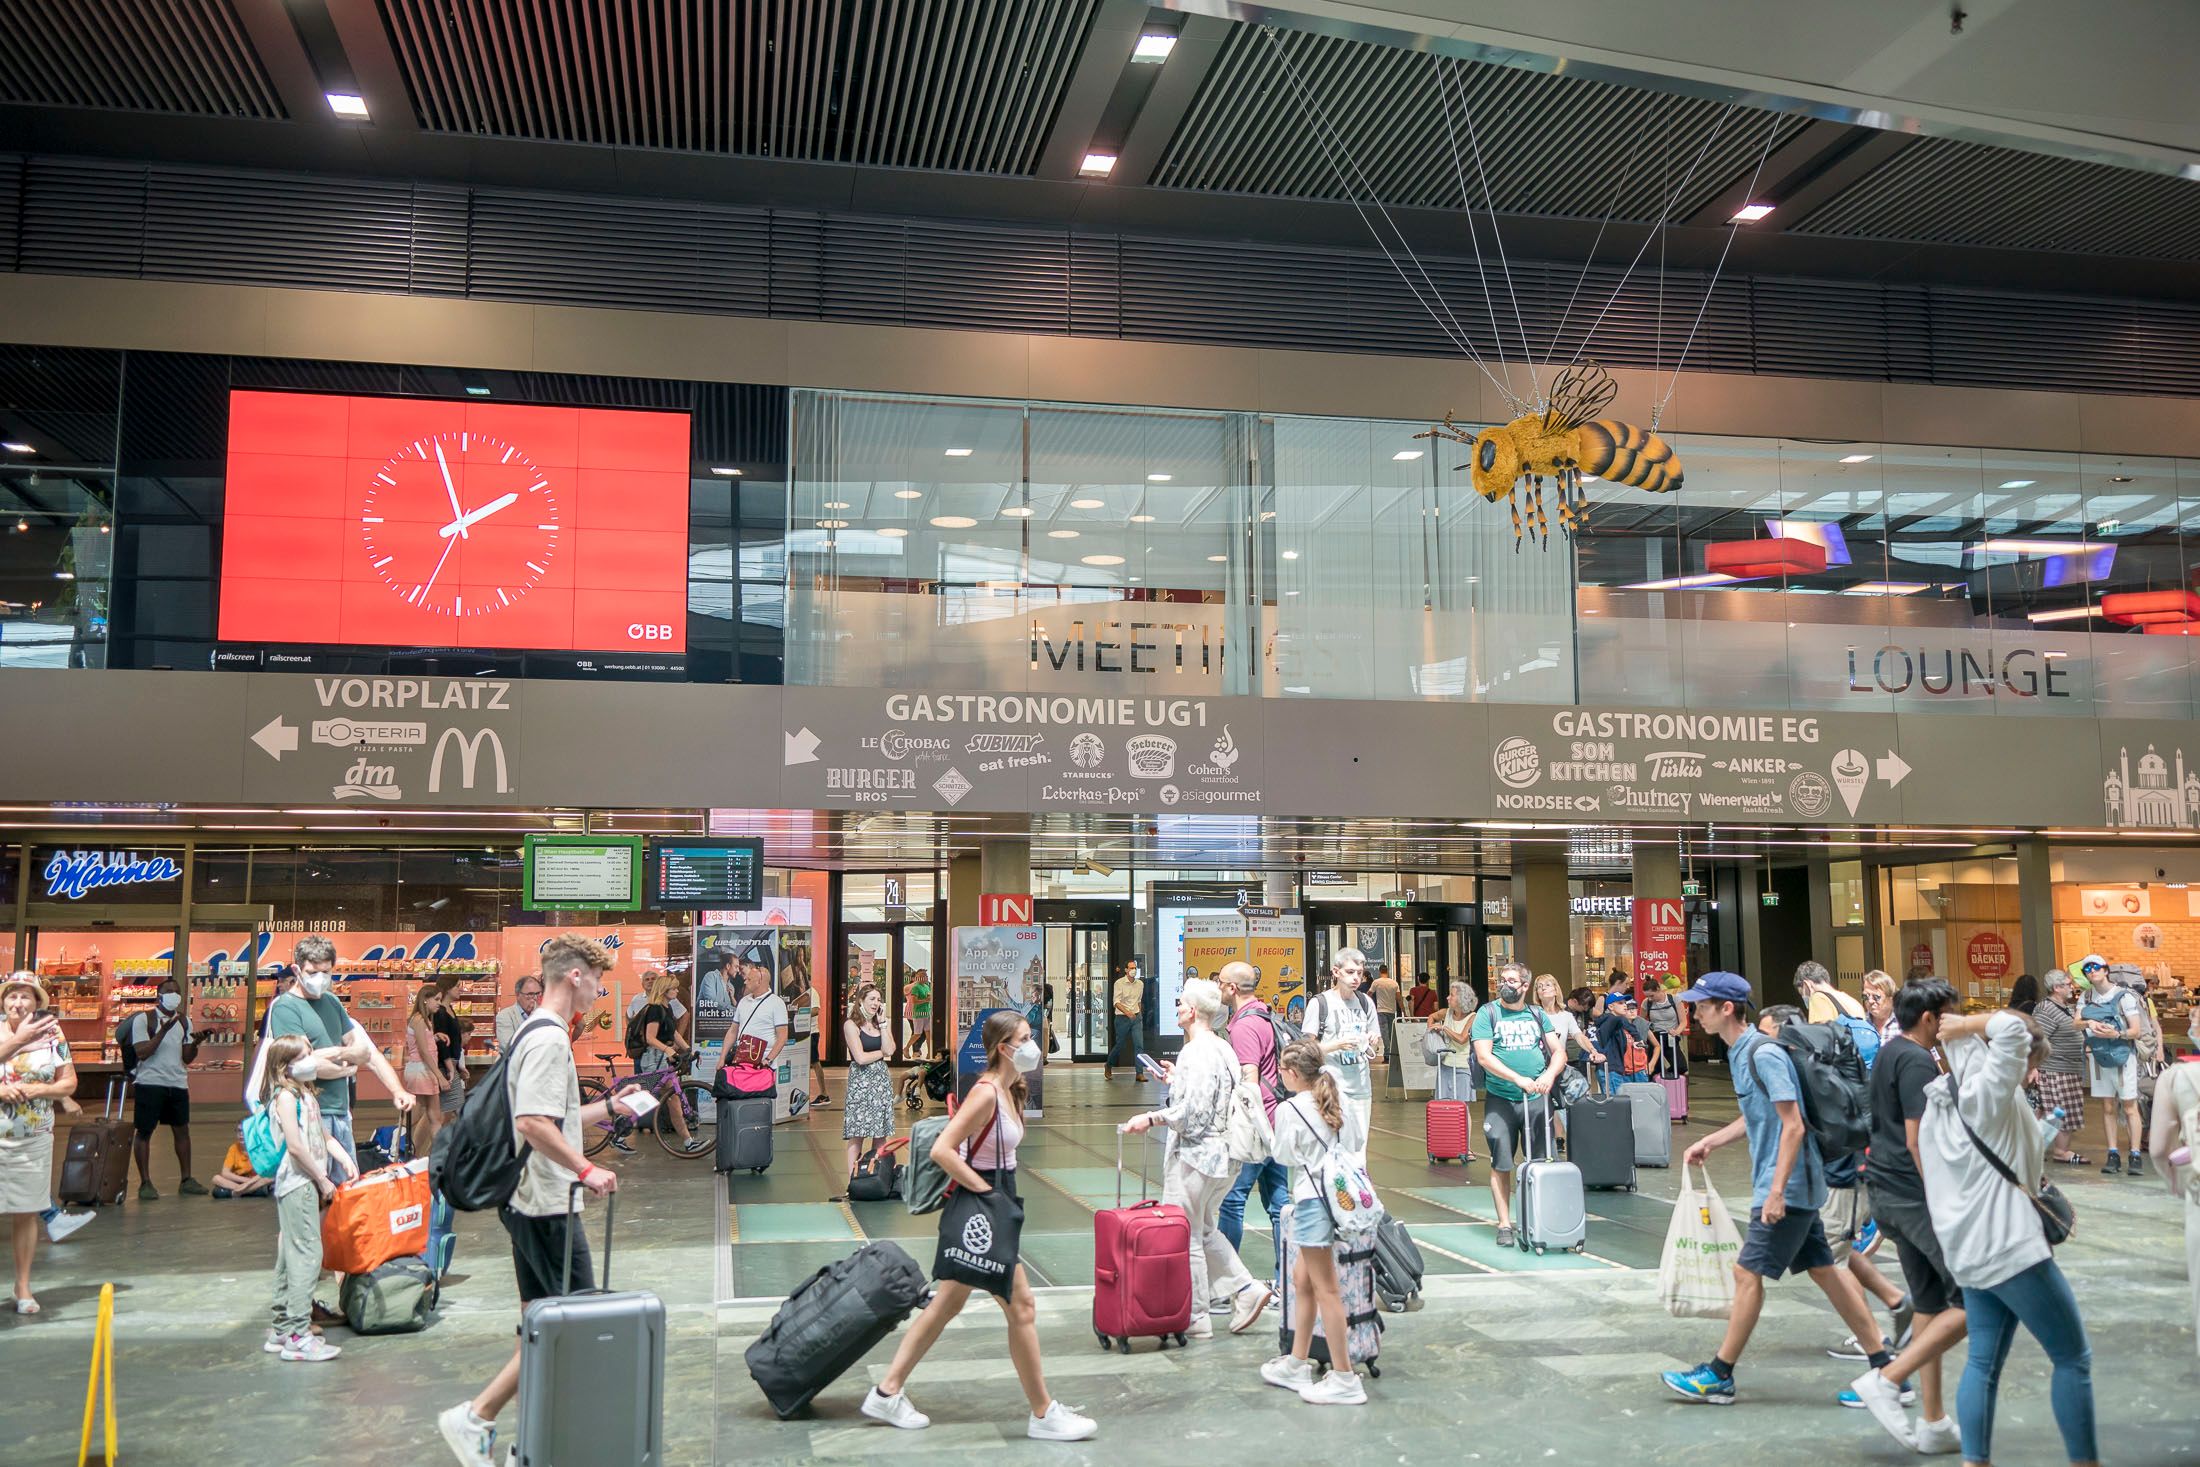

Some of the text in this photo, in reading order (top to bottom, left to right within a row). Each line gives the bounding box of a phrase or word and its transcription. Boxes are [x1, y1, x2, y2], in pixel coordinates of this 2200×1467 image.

[217, 653, 255, 661] railscreen
[269, 654, 312, 663] railscreen.at
[1847, 645, 2070, 697] LOUNGE
[314, 679, 510, 710] VORPLATZ
[885, 694, 1207, 727] GASTRONOMIE UG1
[1552, 711, 1820, 744] GASTRONOMIE EG
[861, 737, 951, 749] LE CROBAG
[967, 733, 1043, 754] SUBWAY
[1498, 744, 1537, 765] BURGER
[1570, 741, 1615, 762] SOM
[345, 757, 395, 785] dm
[979, 758, 1004, 772] eat
[1187, 764, 1231, 775] Cohen's
[1500, 753, 1539, 777] KING
[1549, 761, 1638, 782] KITCHEN
[1644, 751, 1707, 782] Türkis
[1728, 757, 1786, 773] ANKER
[826, 768, 917, 789] BURGER
[1200, 775, 1239, 784] smartfood
[855, 791, 888, 802] BROS
[1181, 788, 1261, 804] asiagourmet
[1496, 794, 1573, 810] NORDSEE
[1610, 784, 1692, 816] Chutney
[1698, 792, 1771, 807] Wienerwald
[44, 852, 183, 899] Manner
[886, 881, 899, 905] 24
[992, 898, 1029, 922] IN
[1573, 897, 1621, 912] COFFEE
[1650, 902, 1685, 925] IN
[964, 948, 1020, 960] App. App
[1200, 947, 1238, 956] REGIOJET
[1262, 947, 1295, 956] REGIOJET
[1639, 951, 1669, 960] Täglich
[965, 961, 1018, 973] und weg.
[1654, 961, 1669, 971] 23
[699, 999, 719, 1008] Bitte
[699, 1008, 720, 1018] nicht
[1675, 1237, 1698, 1249] Wir
[943, 1246, 1007, 1275] TERRALPIN
